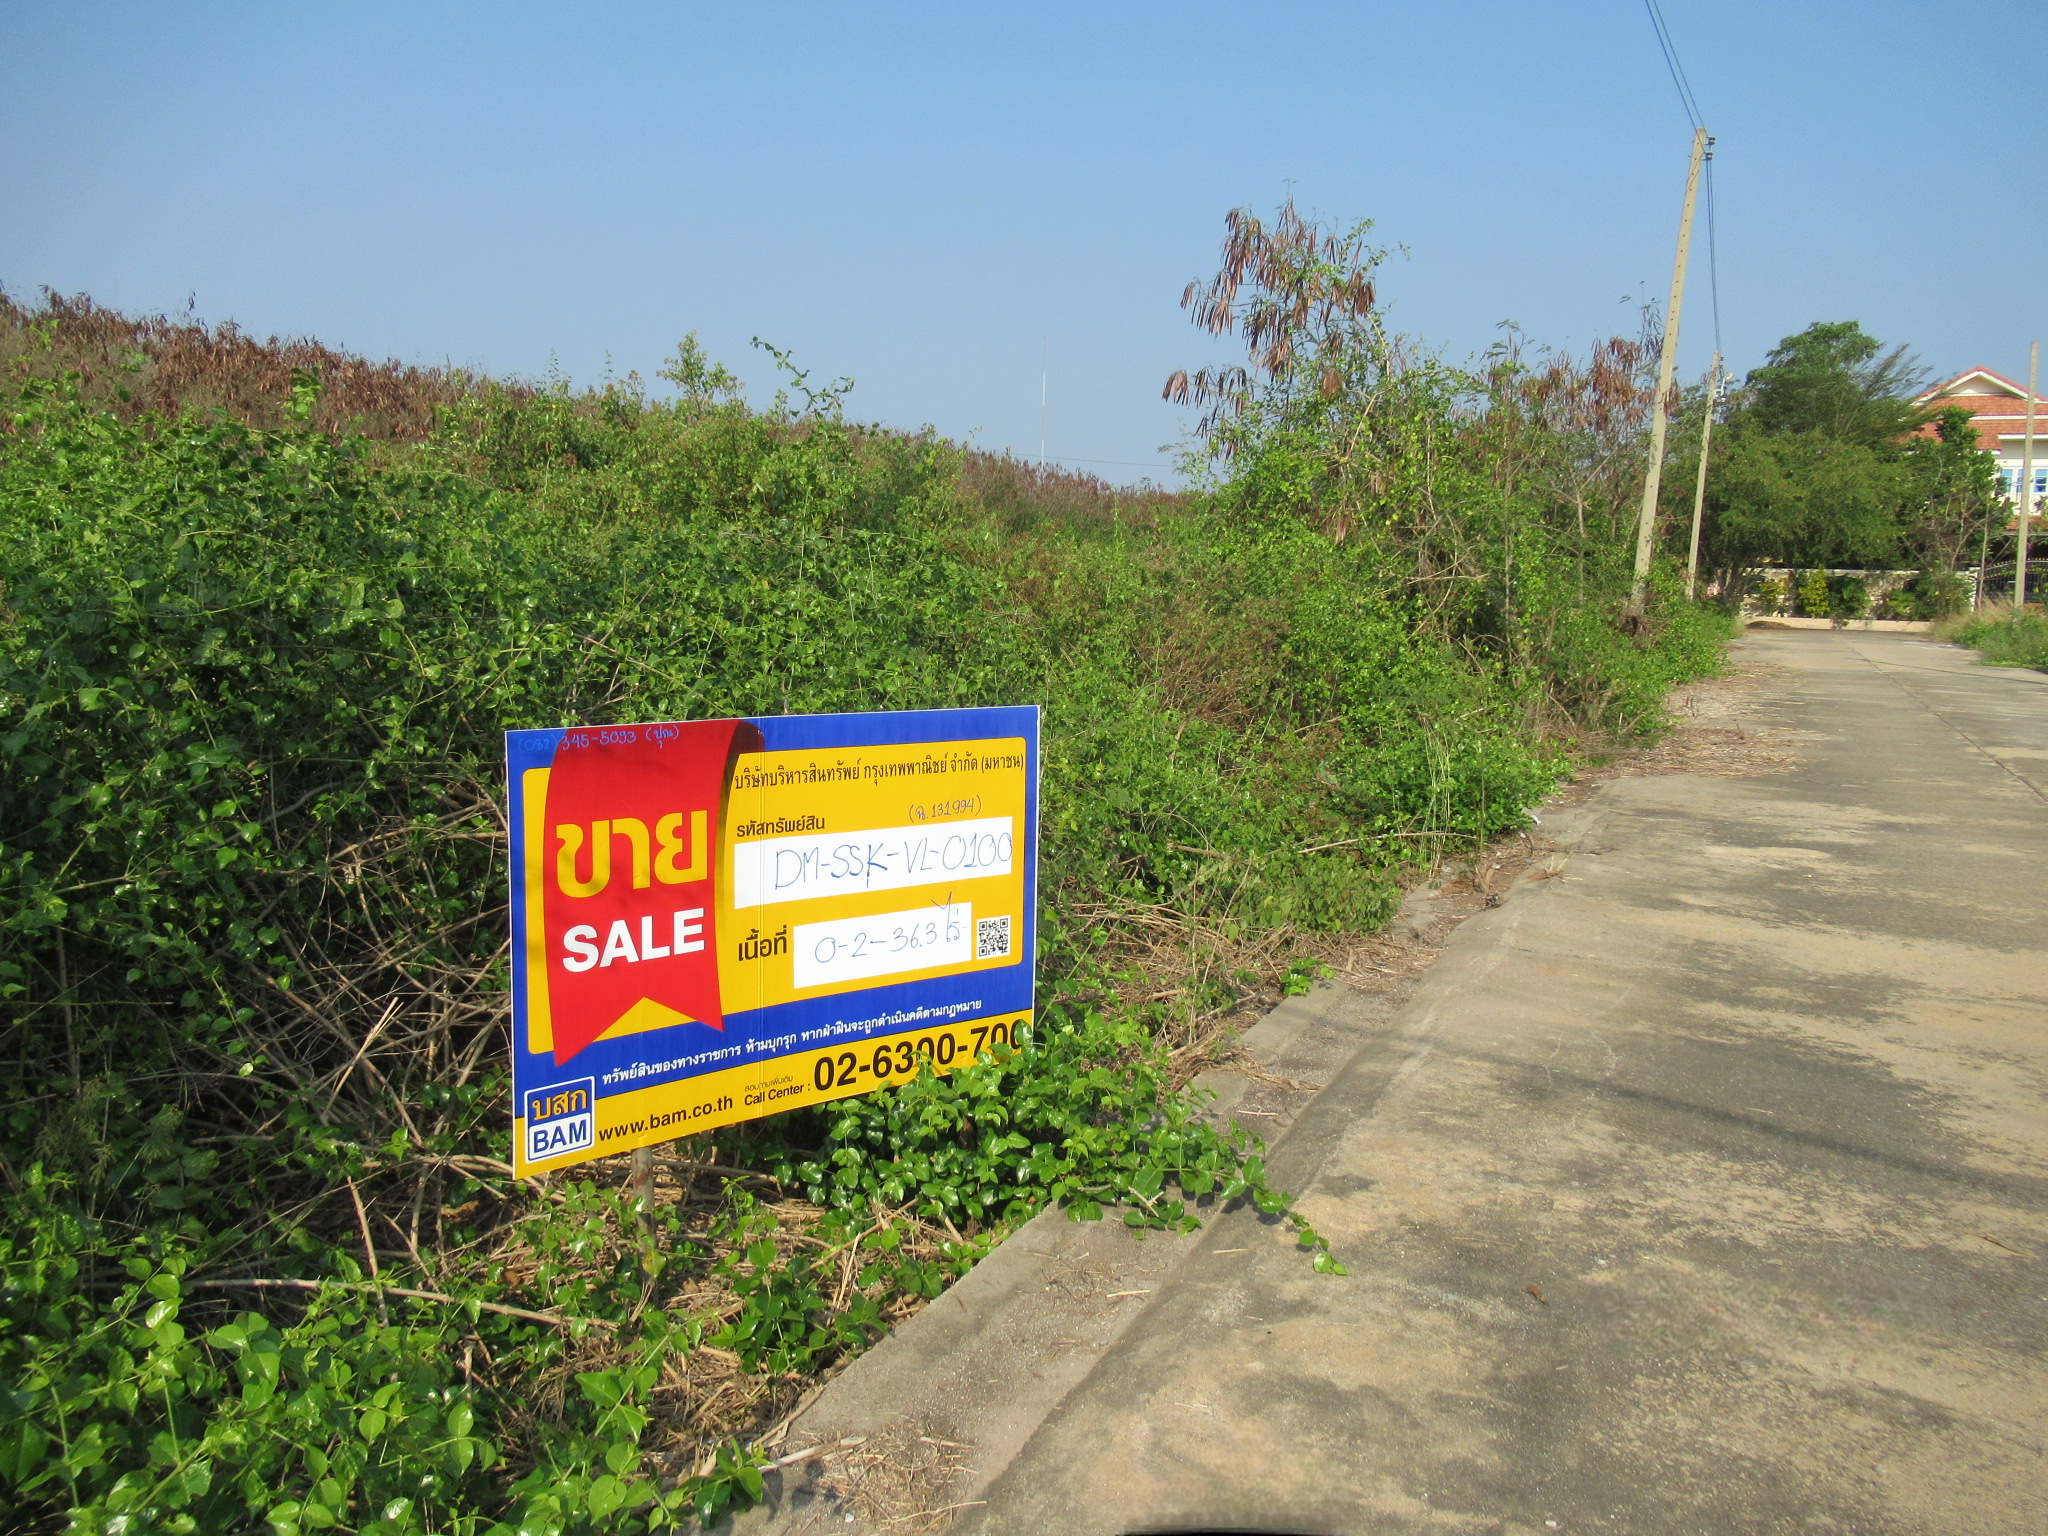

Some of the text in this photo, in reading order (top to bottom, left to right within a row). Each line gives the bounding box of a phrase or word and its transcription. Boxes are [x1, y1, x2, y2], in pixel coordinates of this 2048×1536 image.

[735, 751, 1024, 789] บริษัทบริหารสินทรัพย์ กรุงเทพพาณิชย์ จำกัด (มหาชน)
[736, 814, 825, 837] รหัสทรัพย์สิน
[556, 809, 708, 898] ขาย
[775, 832, 1013, 890] DM-SSK-VL-0100
[562, 907, 705, 973] SALE
[738, 924, 788, 961] เนื้อที่
[602, 1044, 742, 1085] ทรัพย์สินของทางราชการ
[745, 1032, 797, 1055] ห้ามบุกรุก
[532, 1088, 588, 1121] บสก
[744, 1091, 765, 1106] Call
[768, 1084, 804, 1100] Center
[533, 1119, 587, 1154] BAM
[599, 1095, 733, 1141] www.bam.co.th
